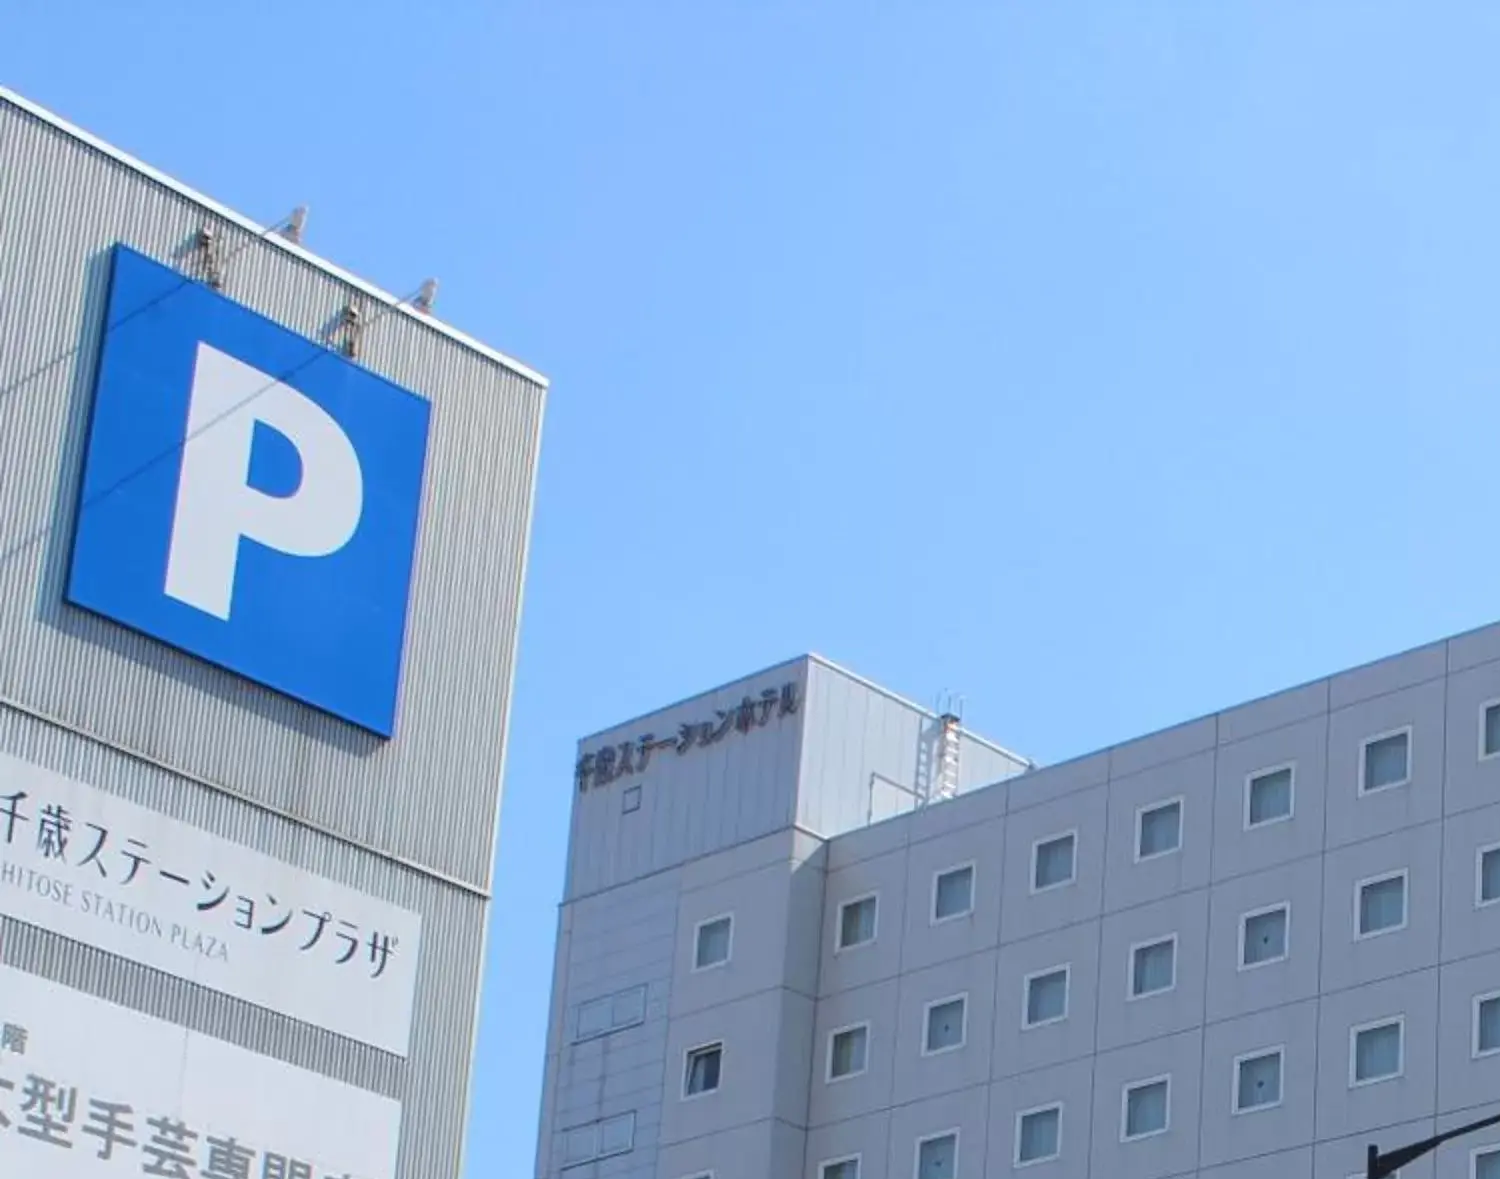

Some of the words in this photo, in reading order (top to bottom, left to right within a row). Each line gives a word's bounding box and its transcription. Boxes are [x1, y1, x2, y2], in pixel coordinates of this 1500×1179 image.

[164, 341, 363, 621] P
[0, 791, 400, 978] 千歳ステーションプラザ
[81, 890, 163, 938] STATION
[171, 923, 229, 962] PLAZA
